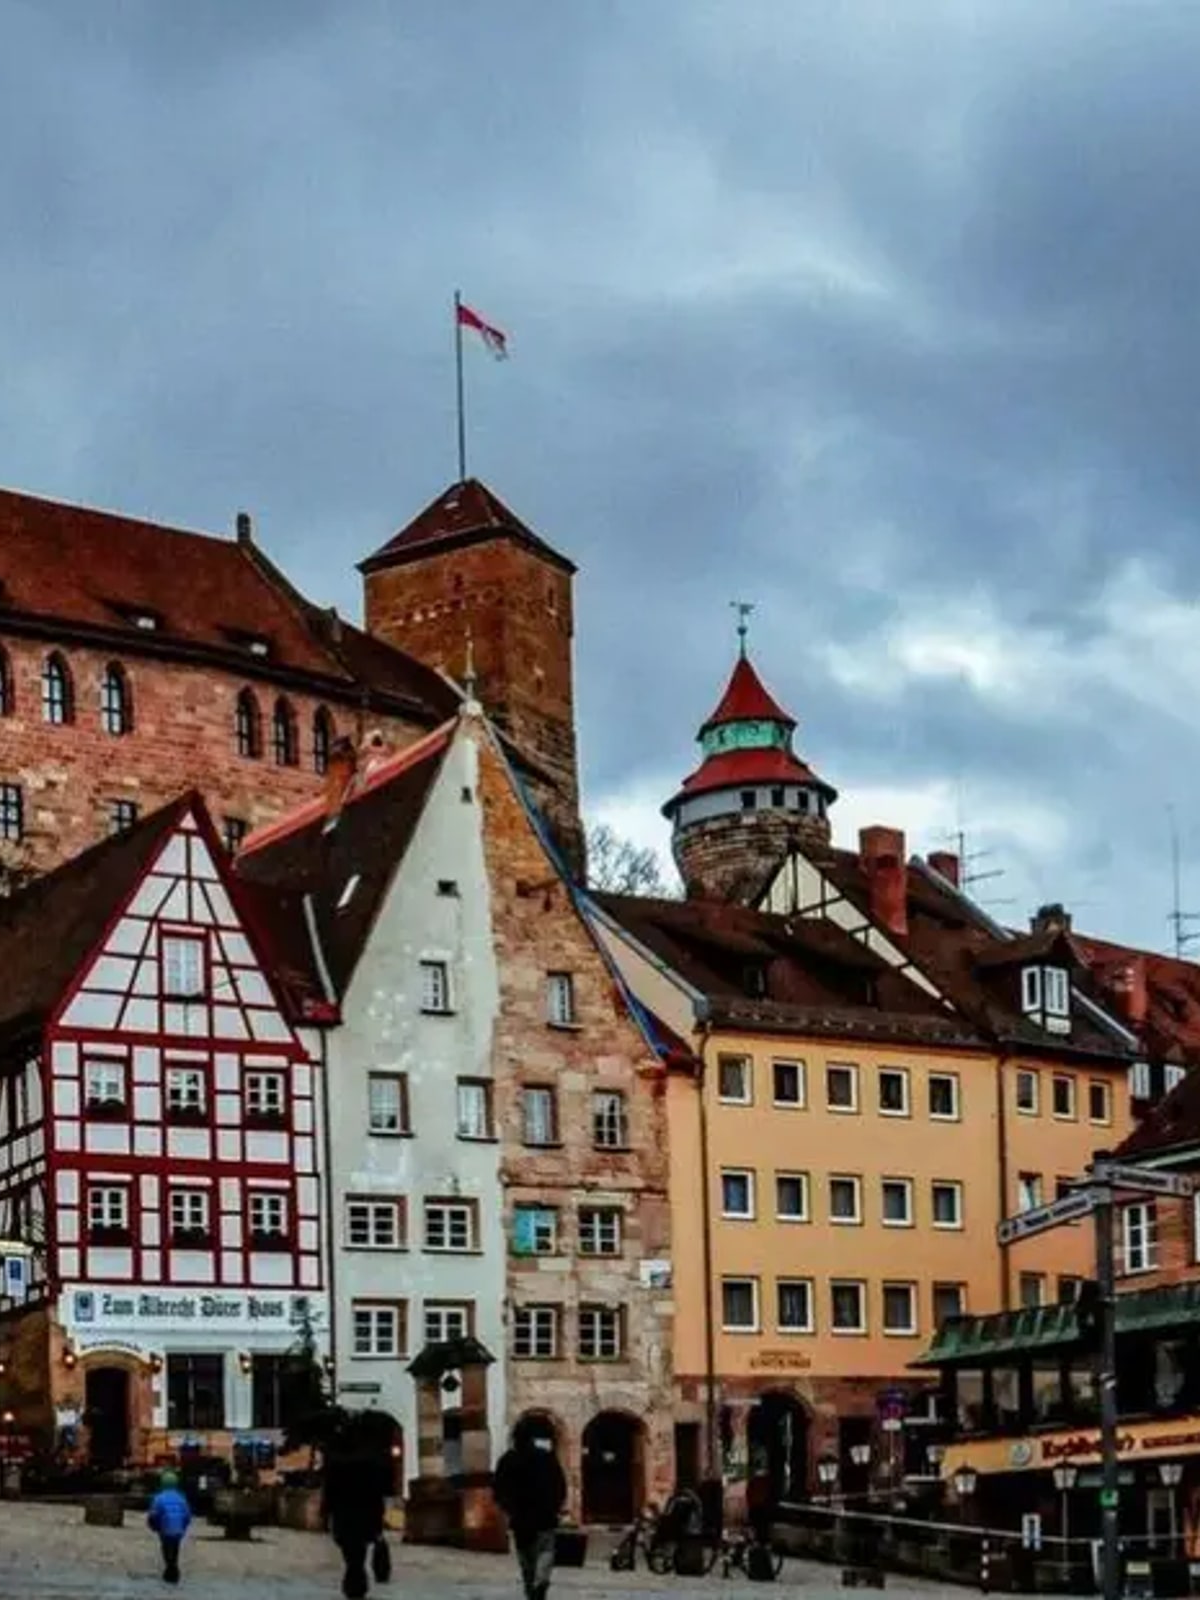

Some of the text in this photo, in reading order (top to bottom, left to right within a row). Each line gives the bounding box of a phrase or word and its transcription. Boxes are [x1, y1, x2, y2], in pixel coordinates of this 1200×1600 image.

[103, 1294, 283, 1320] Zum Albrecht Dürer Haus
